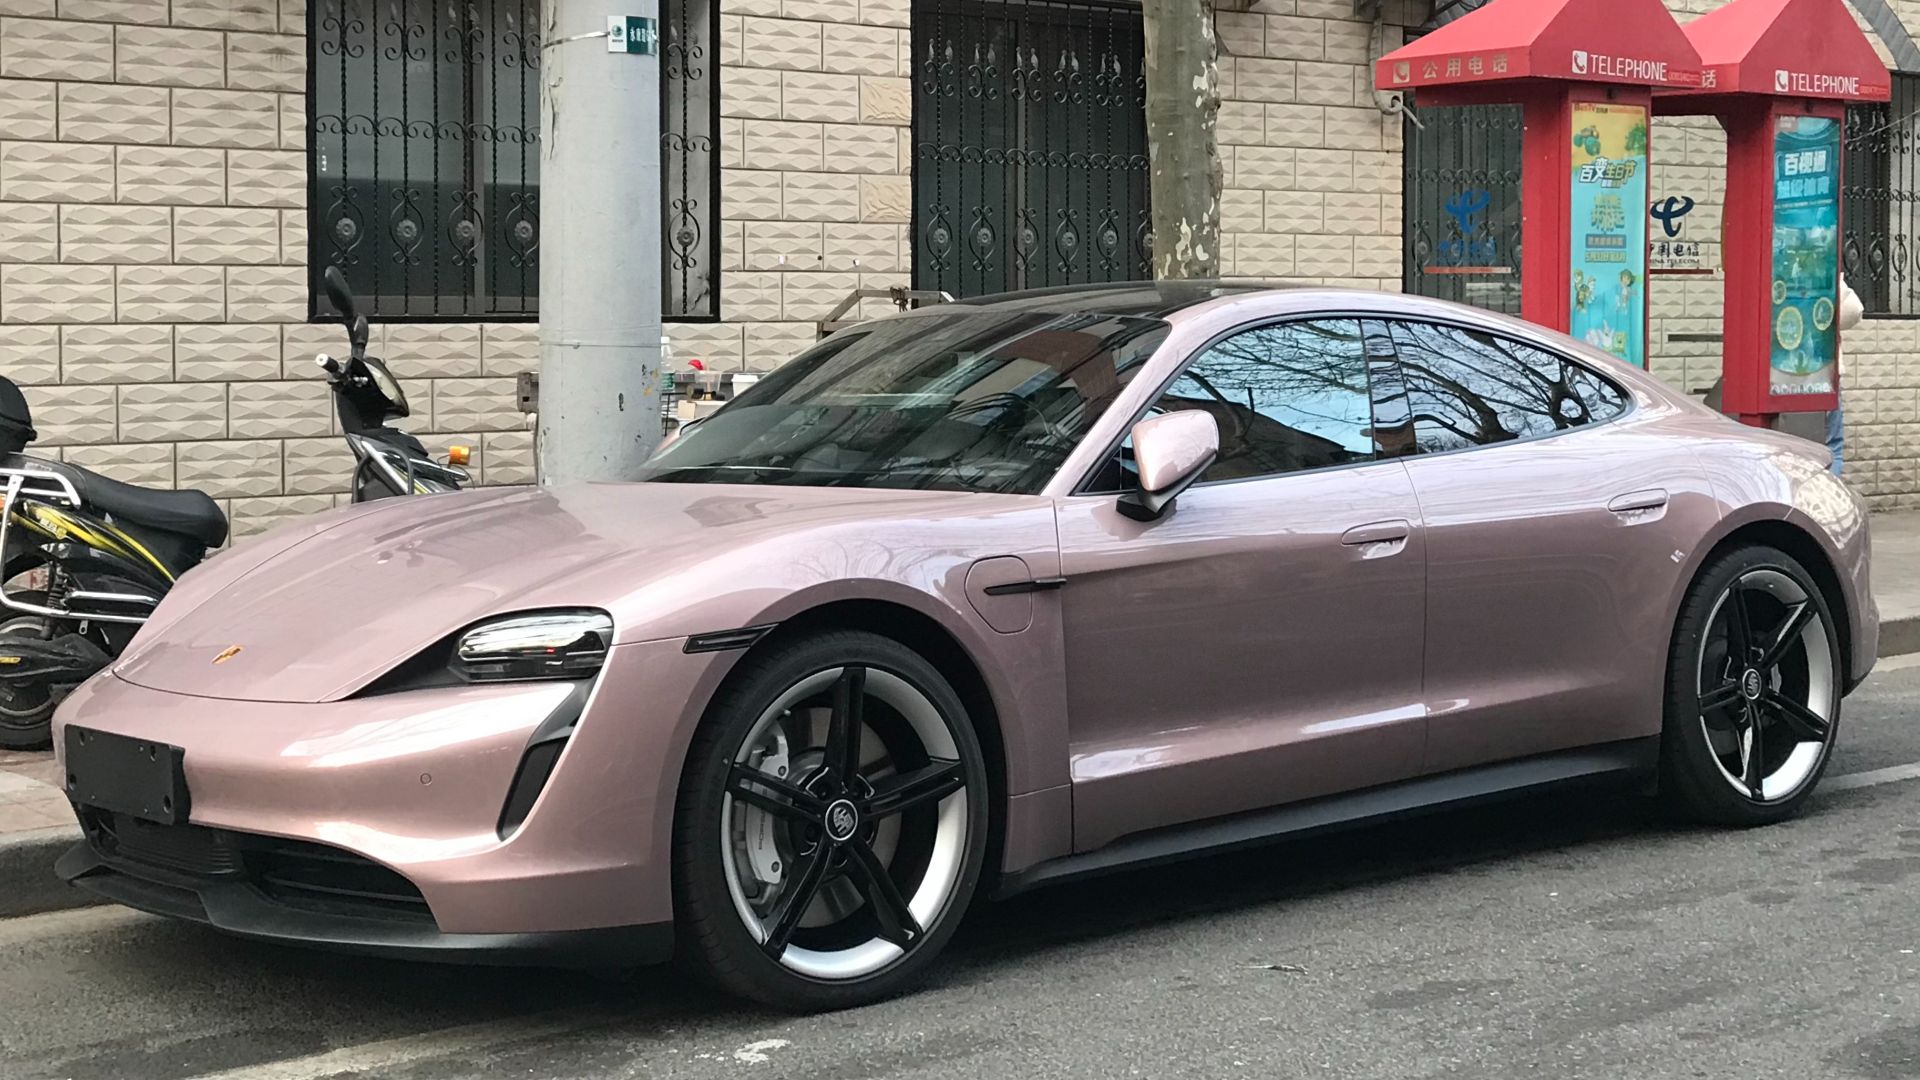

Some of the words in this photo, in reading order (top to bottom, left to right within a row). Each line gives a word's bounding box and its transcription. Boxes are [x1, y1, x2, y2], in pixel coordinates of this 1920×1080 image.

[1422, 54, 1508, 79] 公用电话
[1590, 54, 1668, 81] TELEPHONE
[1702, 69, 1716, 88] 话
[1791, 72, 1860, 95] TELEPHONE
